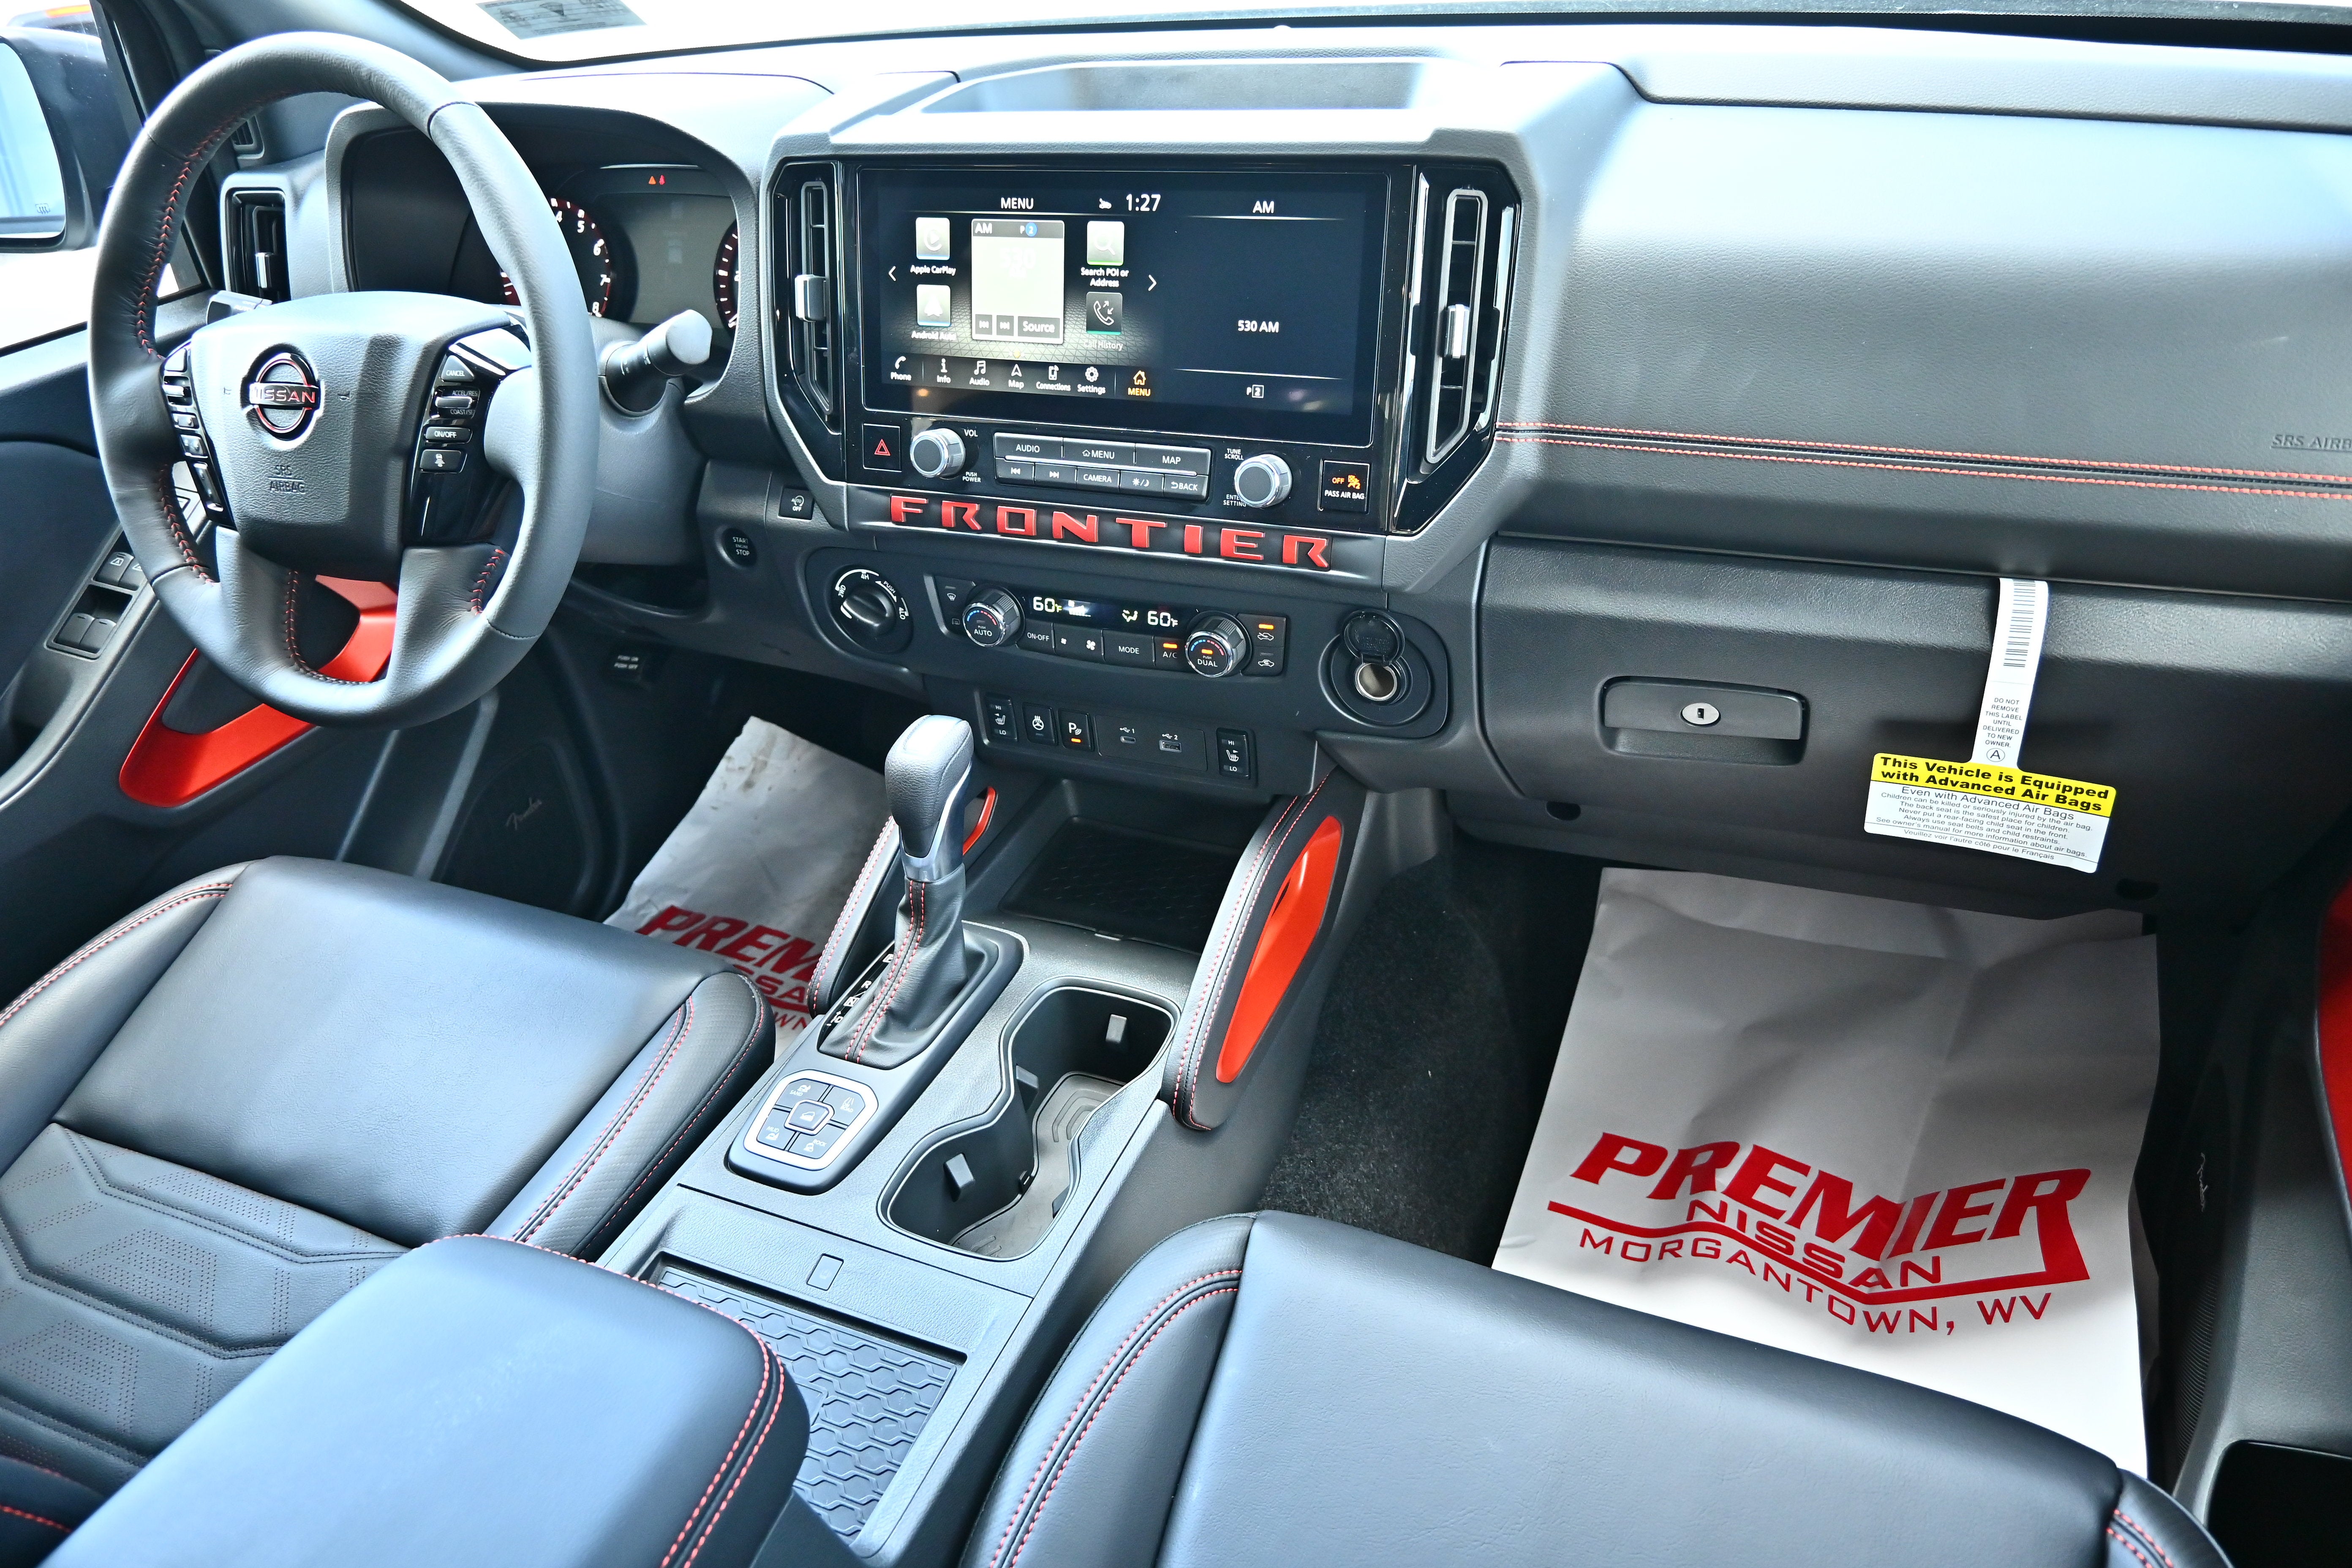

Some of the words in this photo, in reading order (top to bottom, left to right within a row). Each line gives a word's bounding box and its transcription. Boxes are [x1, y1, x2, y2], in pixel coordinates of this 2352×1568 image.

[1001, 197, 1034, 209] MENU
[1126, 194, 1161, 211] 1:27
[1252, 201, 1274, 214] AM
[577, 220, 585, 233] 5
[975, 223, 992, 234] AM
[593, 242, 601, 256] 6
[910, 265, 930, 275] Apple
[931, 266, 956, 276] CarPlay
[1081, 267, 1105, 276] Search
[1106, 268, 1119, 277] POI
[1090, 278, 1119, 287] Address
[592, 301, 599, 313] 8
[1023, 321, 1055, 333] Source
[1238, 320, 1258, 332] 530
[1259, 321, 1279, 332] AM
[1098, 341, 1123, 351] History
[890, 372, 912, 381] Phone
[937, 375, 951, 384] Info
[969, 377, 990, 386] Audio
[1008, 379, 1024, 390] Map
[1036, 381, 1071, 392] Connections
[1077, 384, 1105, 395] Settings
[1128, 387, 1151, 397] MENU
[434, 430, 457, 438] ON/OFF
[2272, 434, 2304, 446] SRS
[1016, 444, 1040, 453] AUDIO
[1092, 450, 1115, 459] MENU
[1162, 455, 1181, 465] MAP
[274, 465, 293, 476] SRS
[1083, 474, 1112, 483] CAMERA
[1179, 482, 1198, 491] BACK
[890, 495, 1329, 568] FRONTIER
[838, 585, 846, 598] 2WD
[883, 580, 896, 593] PUSH
[974, 629, 993, 637] AUTO
[1118, 645, 1140, 654] MODE
[1197, 659, 1218, 667] DUAL
[1991, 705, 2019, 713] REMOVE
[1983, 725, 2020, 735] DELIVERED
[1985, 740, 2011, 748] OWNER.
[1990, 750, 2001, 760] A
[1881, 757, 1918, 770] This
[1925, 762, 1992, 779] Vehicle
[1998, 772, 2014, 782] is
[2020, 775, 2109, 799] Equipped
[1881, 771, 1919, 782] with
[1925, 775, 2015, 795] Advanced
[2021, 789, 2049, 801] Air
[2055, 794, 2102, 811] Bags
[1902, 786, 1930, 797] Even
[1935, 791, 1957, 800] with
[1960, 794, 2020, 810] Advanced
[2023, 804, 2040, 813] Air
[2044, 807, 2074, 820] Bags
[1881, 792, 1911, 801] Children
[1973, 805, 2006, 816] seriously
[2009, 811, 2035, 819] injured
[2076, 823, 2093, 831] bag.
[1944, 814, 1984, 825] rear-facing
[2049, 830, 2068, 839] front.
[1977, 812, 1999, 820] safest
[2001, 817, 2022, 825] place
[2037, 823, 2070, 833] children.
[1904, 814, 1930, 823] Always
[1966, 823, 1984, 831] belts
[2023, 833, 2060, 844] restraints.
[1892, 819, 1921, 828] owner's
[1923, 823, 1950, 832] manual
[1986, 834, 2028, 845] information
[2030, 841, 2052, 850] about
[2066, 848, 2087, 858] bags.
[1904, 829, 1932, 838] Veuillez
[2022, 849, 2055, 860] Français
[861, 980, 872, 988] R
[813, 1139, 827, 1147] ROCK
[1569, 1132, 2091, 1279] PREMIER
[1686, 1199, 1942, 1291] NISSAN
[1579, 1228, 1955, 1336] MORGANTOWN,
[1976, 1293, 2052, 1325] WV
